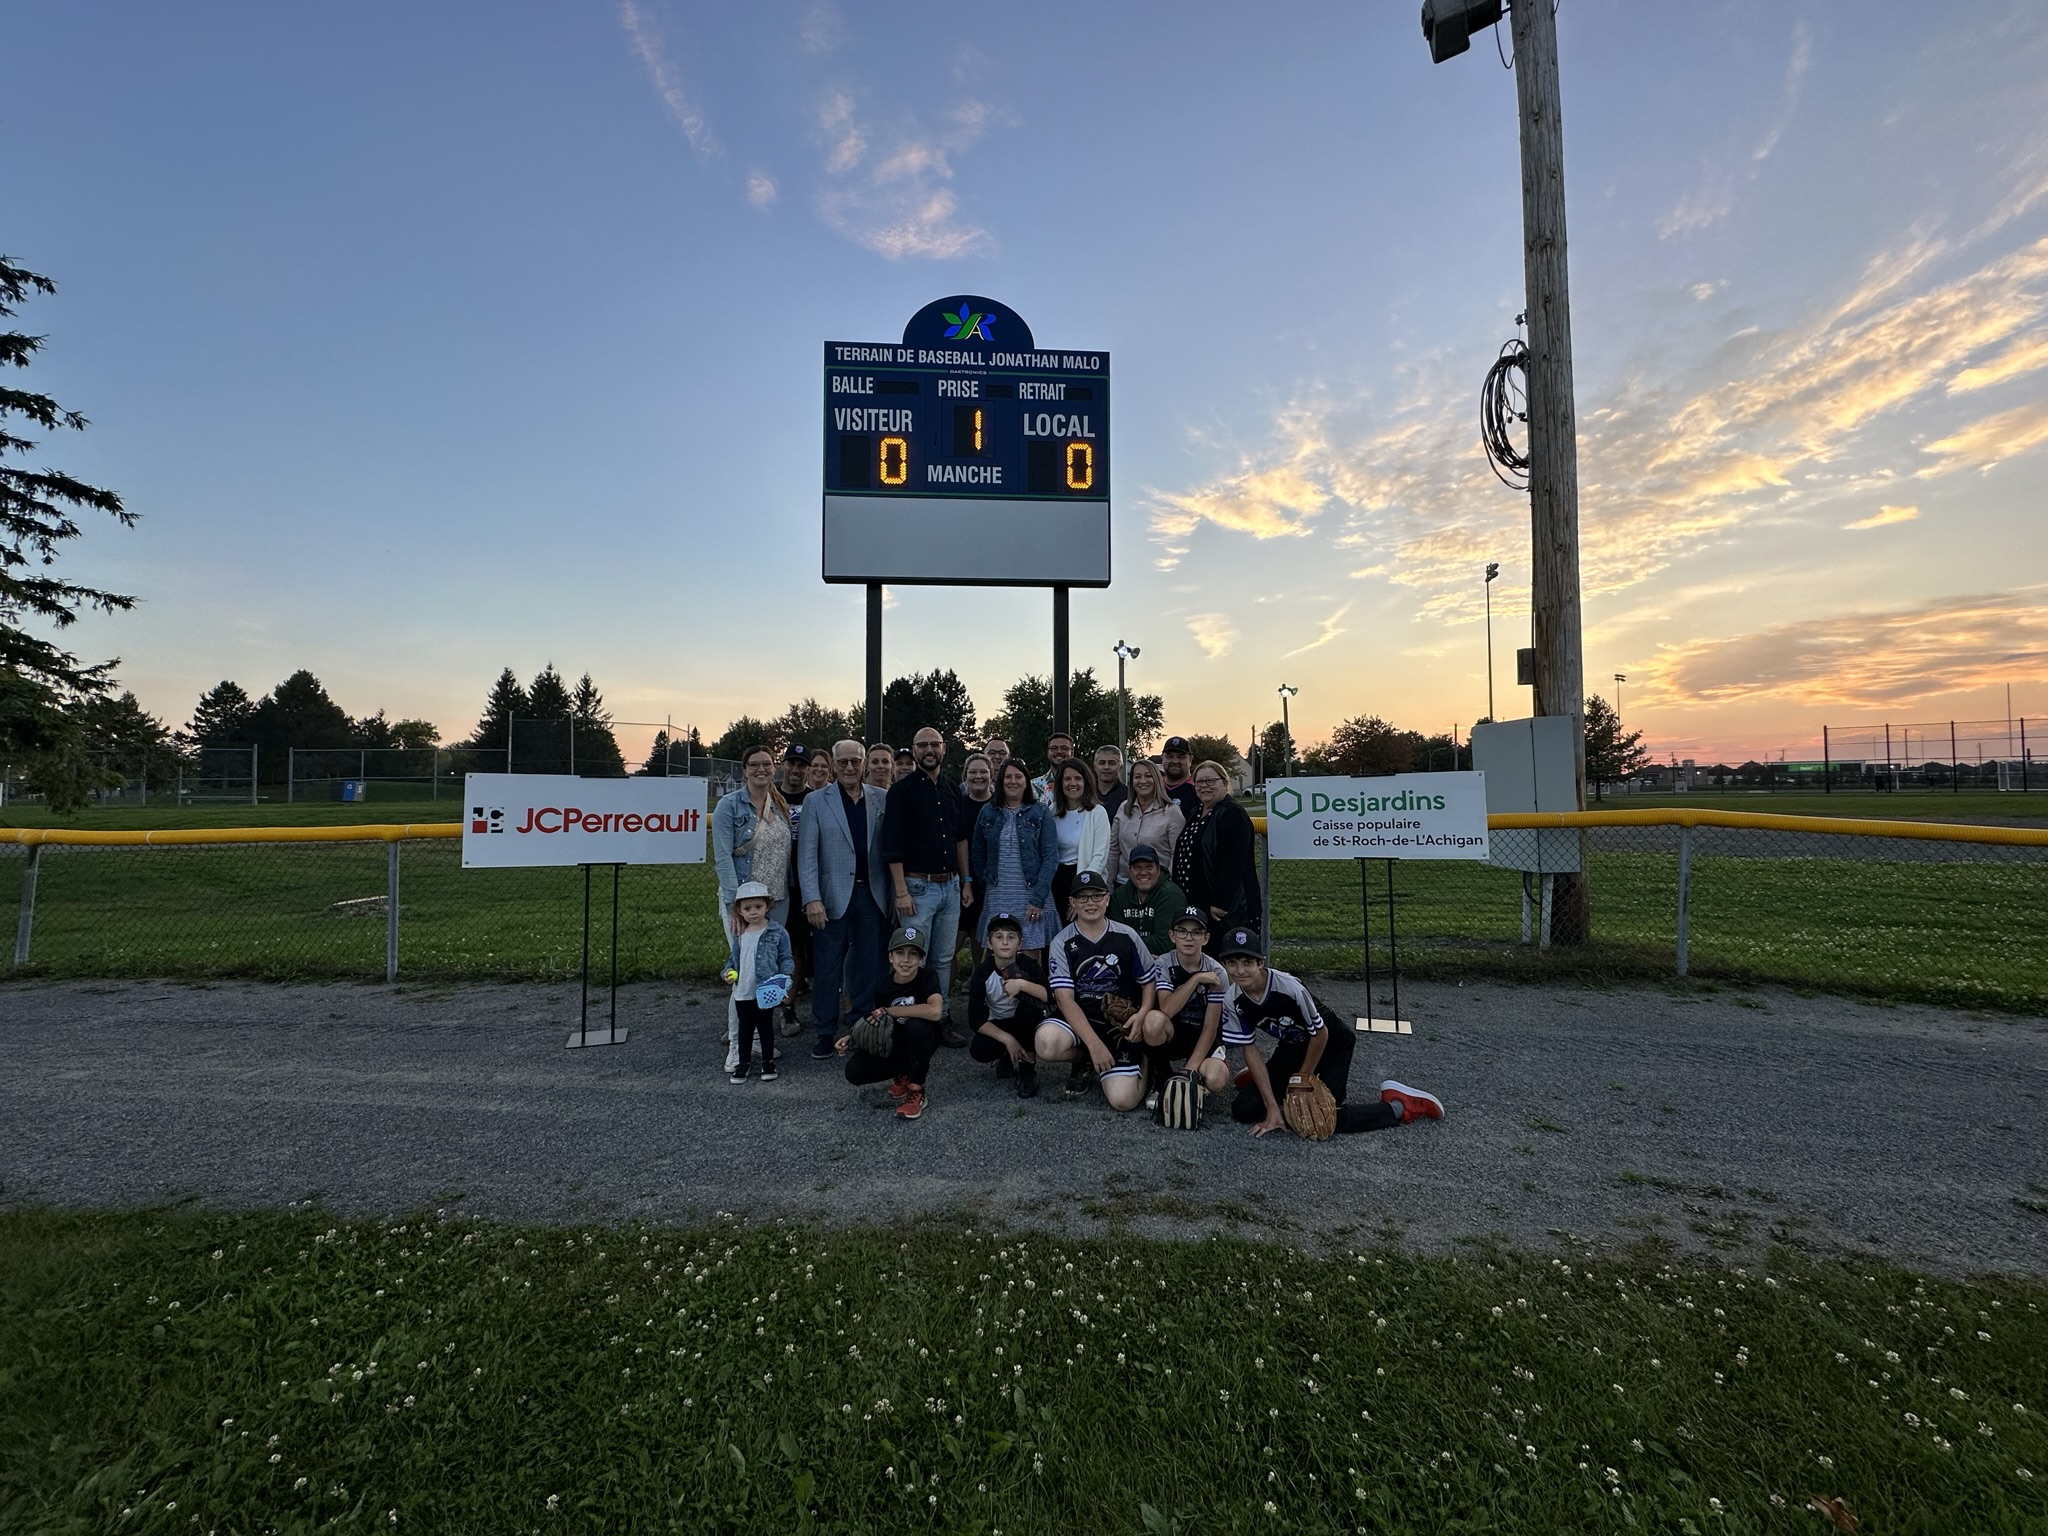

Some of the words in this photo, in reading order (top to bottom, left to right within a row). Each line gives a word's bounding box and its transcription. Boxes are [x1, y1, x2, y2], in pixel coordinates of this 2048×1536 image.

[835, 346, 893, 362] TERRAIN
[898, 348, 915, 363] DE
[918, 350, 986, 366] BASEBALL
[989, 352, 1058, 369] JONATHAN
[1063, 355, 1100, 370] MALO
[832, 375, 874, 395] BALLE
[938, 379, 979, 398] PRISE
[1019, 382, 1066, 400] RETRAIT
[834, 407, 913, 432] VISITEUR
[974, 409, 983, 451] 1
[1023, 413, 1096, 438] LOCAL
[879, 437, 908, 485] 0
[1066, 442, 1093, 490] 0
[927, 464, 1002, 484] MANCHE
[1311, 790, 1446, 817] Desjardins
[516, 807, 700, 833] JCPerreault
[1312, 819, 1354, 830] Caisse
[1357, 818, 1421, 832] populaire
[1313, 835, 1329, 847] de
[1332, 833, 1484, 848] St-Roch-de-L'Achigan
